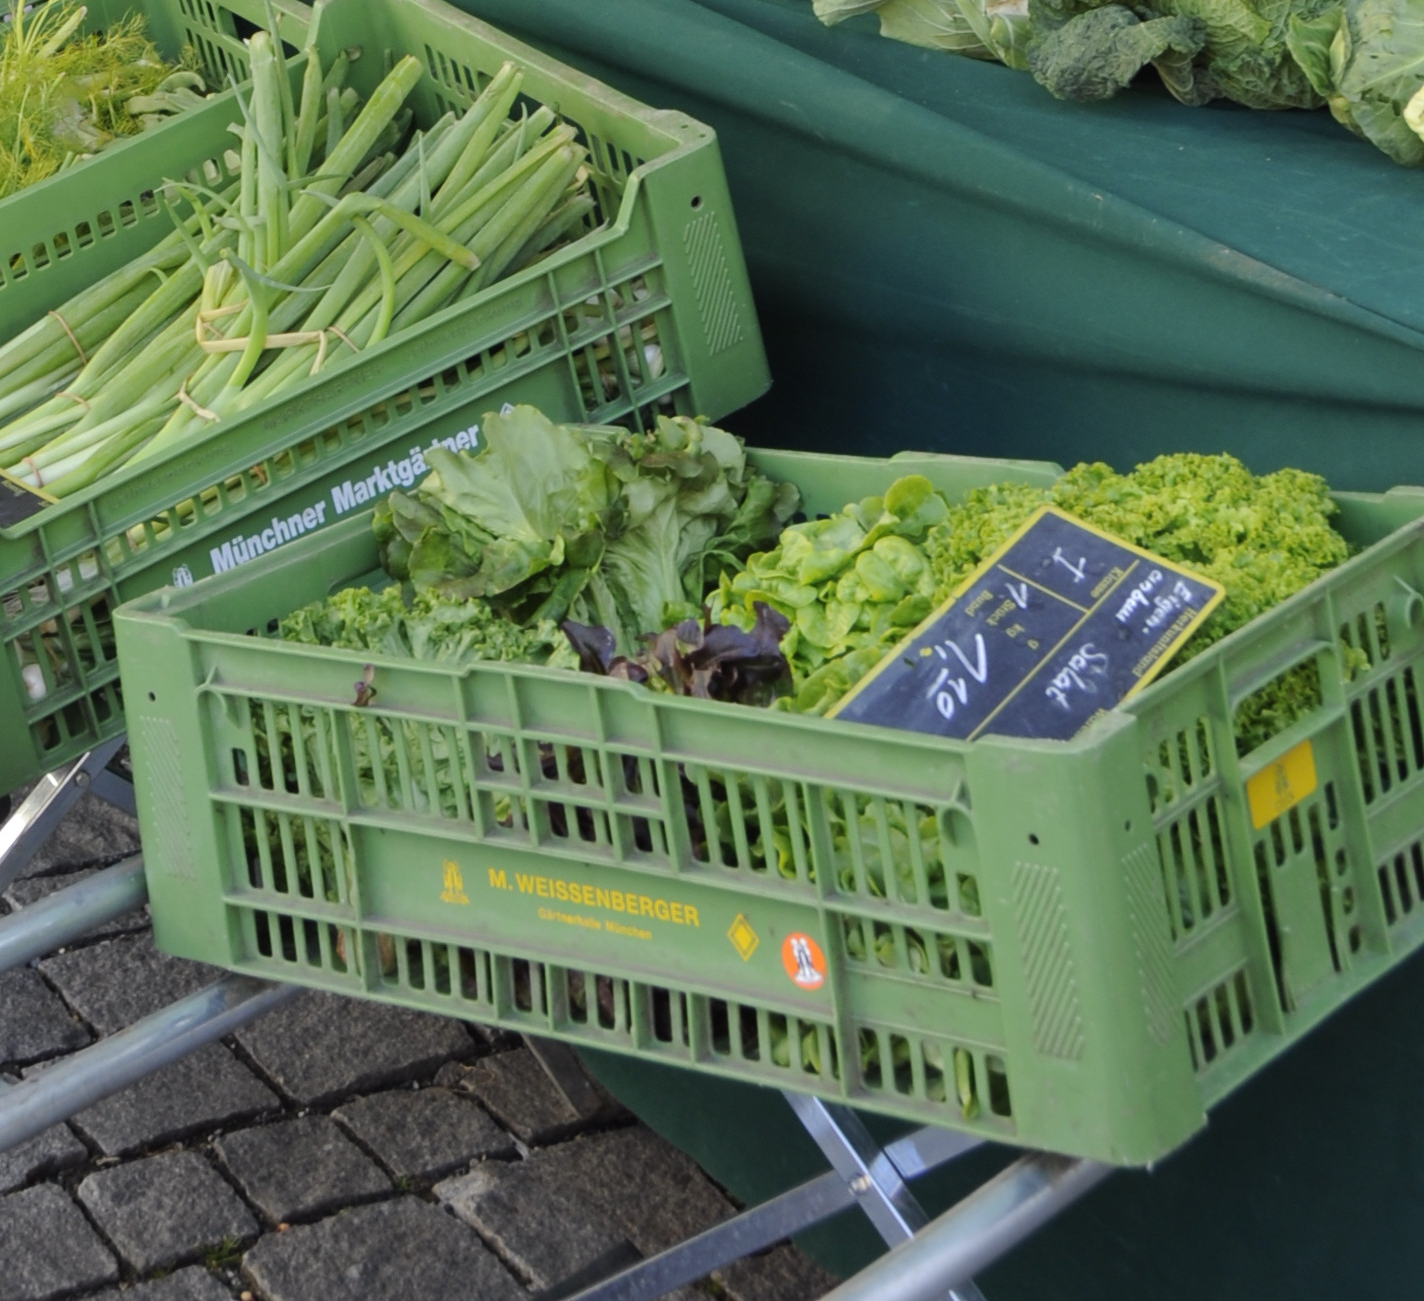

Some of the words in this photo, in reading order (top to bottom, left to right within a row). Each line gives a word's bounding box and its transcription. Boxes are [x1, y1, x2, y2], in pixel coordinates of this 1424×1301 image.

[209, 500, 326, 575] Münchner
[331, 424, 479, 516] Marktgäner
[1045, 642, 1109, 711] Salat
[1132, 607, 1198, 678] Herkunftsland
[488, 867, 514, 892] M.
[515, 872, 701, 927] WEISSENBERGER
